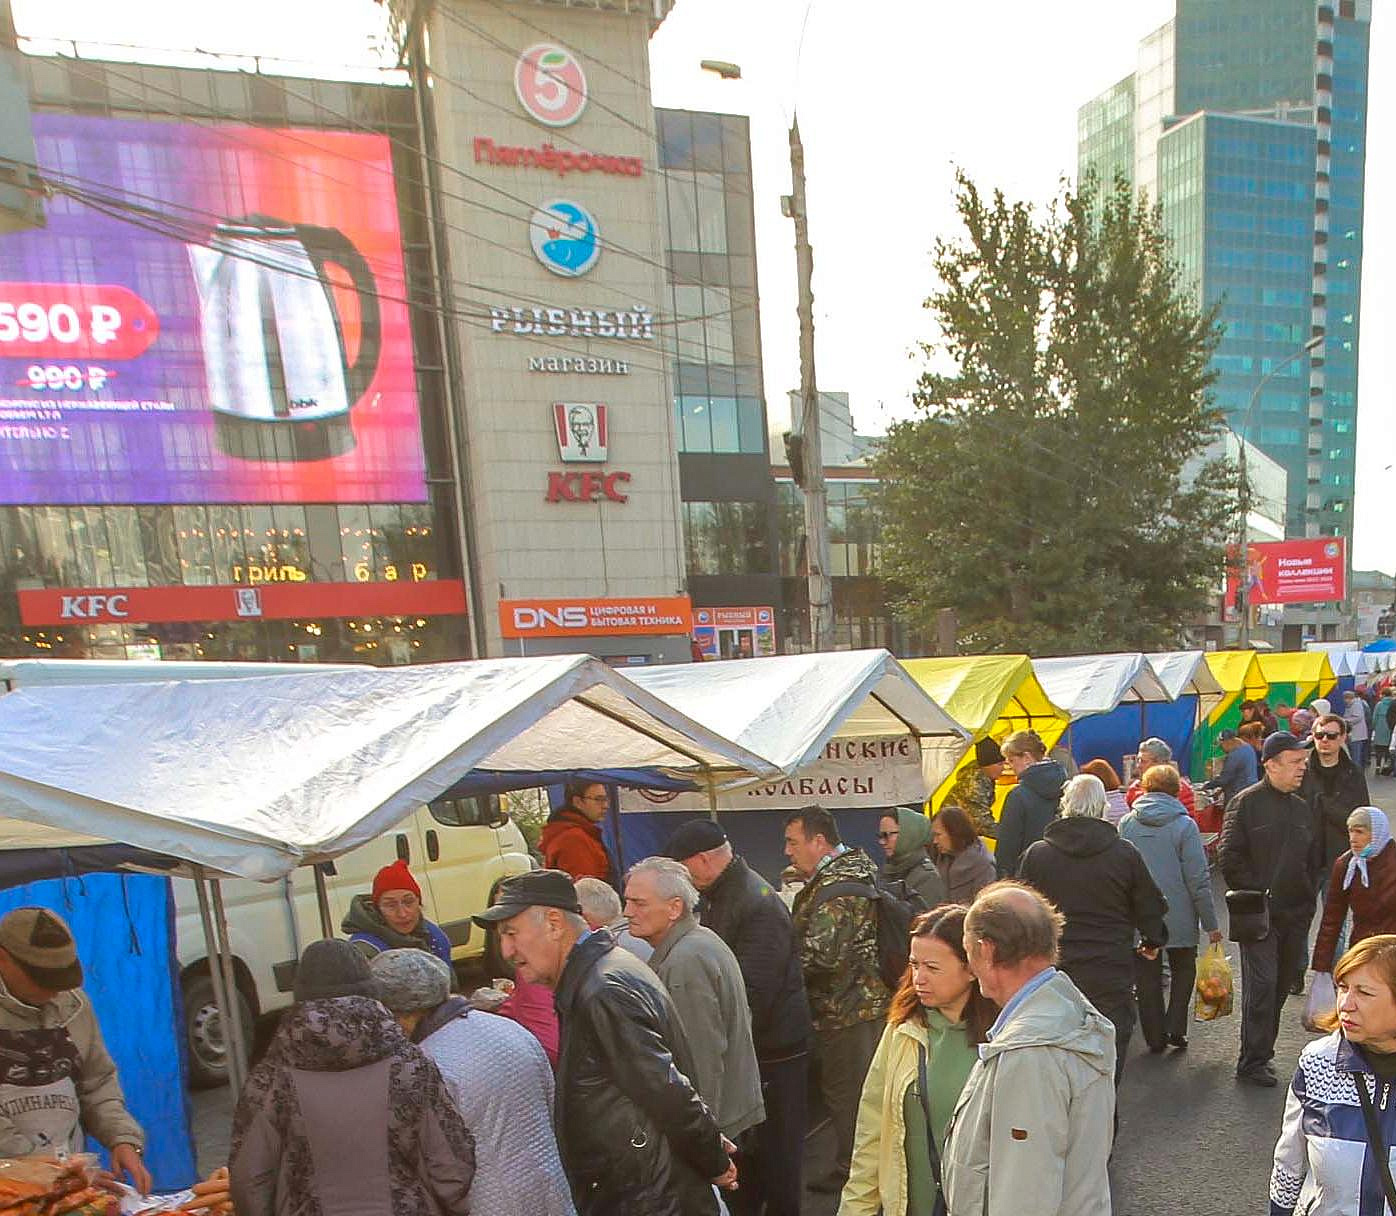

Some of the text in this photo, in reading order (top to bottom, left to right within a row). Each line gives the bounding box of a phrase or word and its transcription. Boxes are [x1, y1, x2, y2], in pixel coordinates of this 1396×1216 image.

[491, 303, 655, 340] РЫБНЫЙ
[529, 356, 630, 376] магазин
[27, 364, 84, 392] 990
[545, 472, 631, 504] KFC
[60, 594, 129, 618] KFC
[513, 606, 587, 628] DNS
[590, 605, 657, 616] ЦИФРОВАЯ И
[591, 615, 684, 627] БЫТОВАЯ ТЕХНИКА
[820, 738, 910, 760] НСКИЕ
